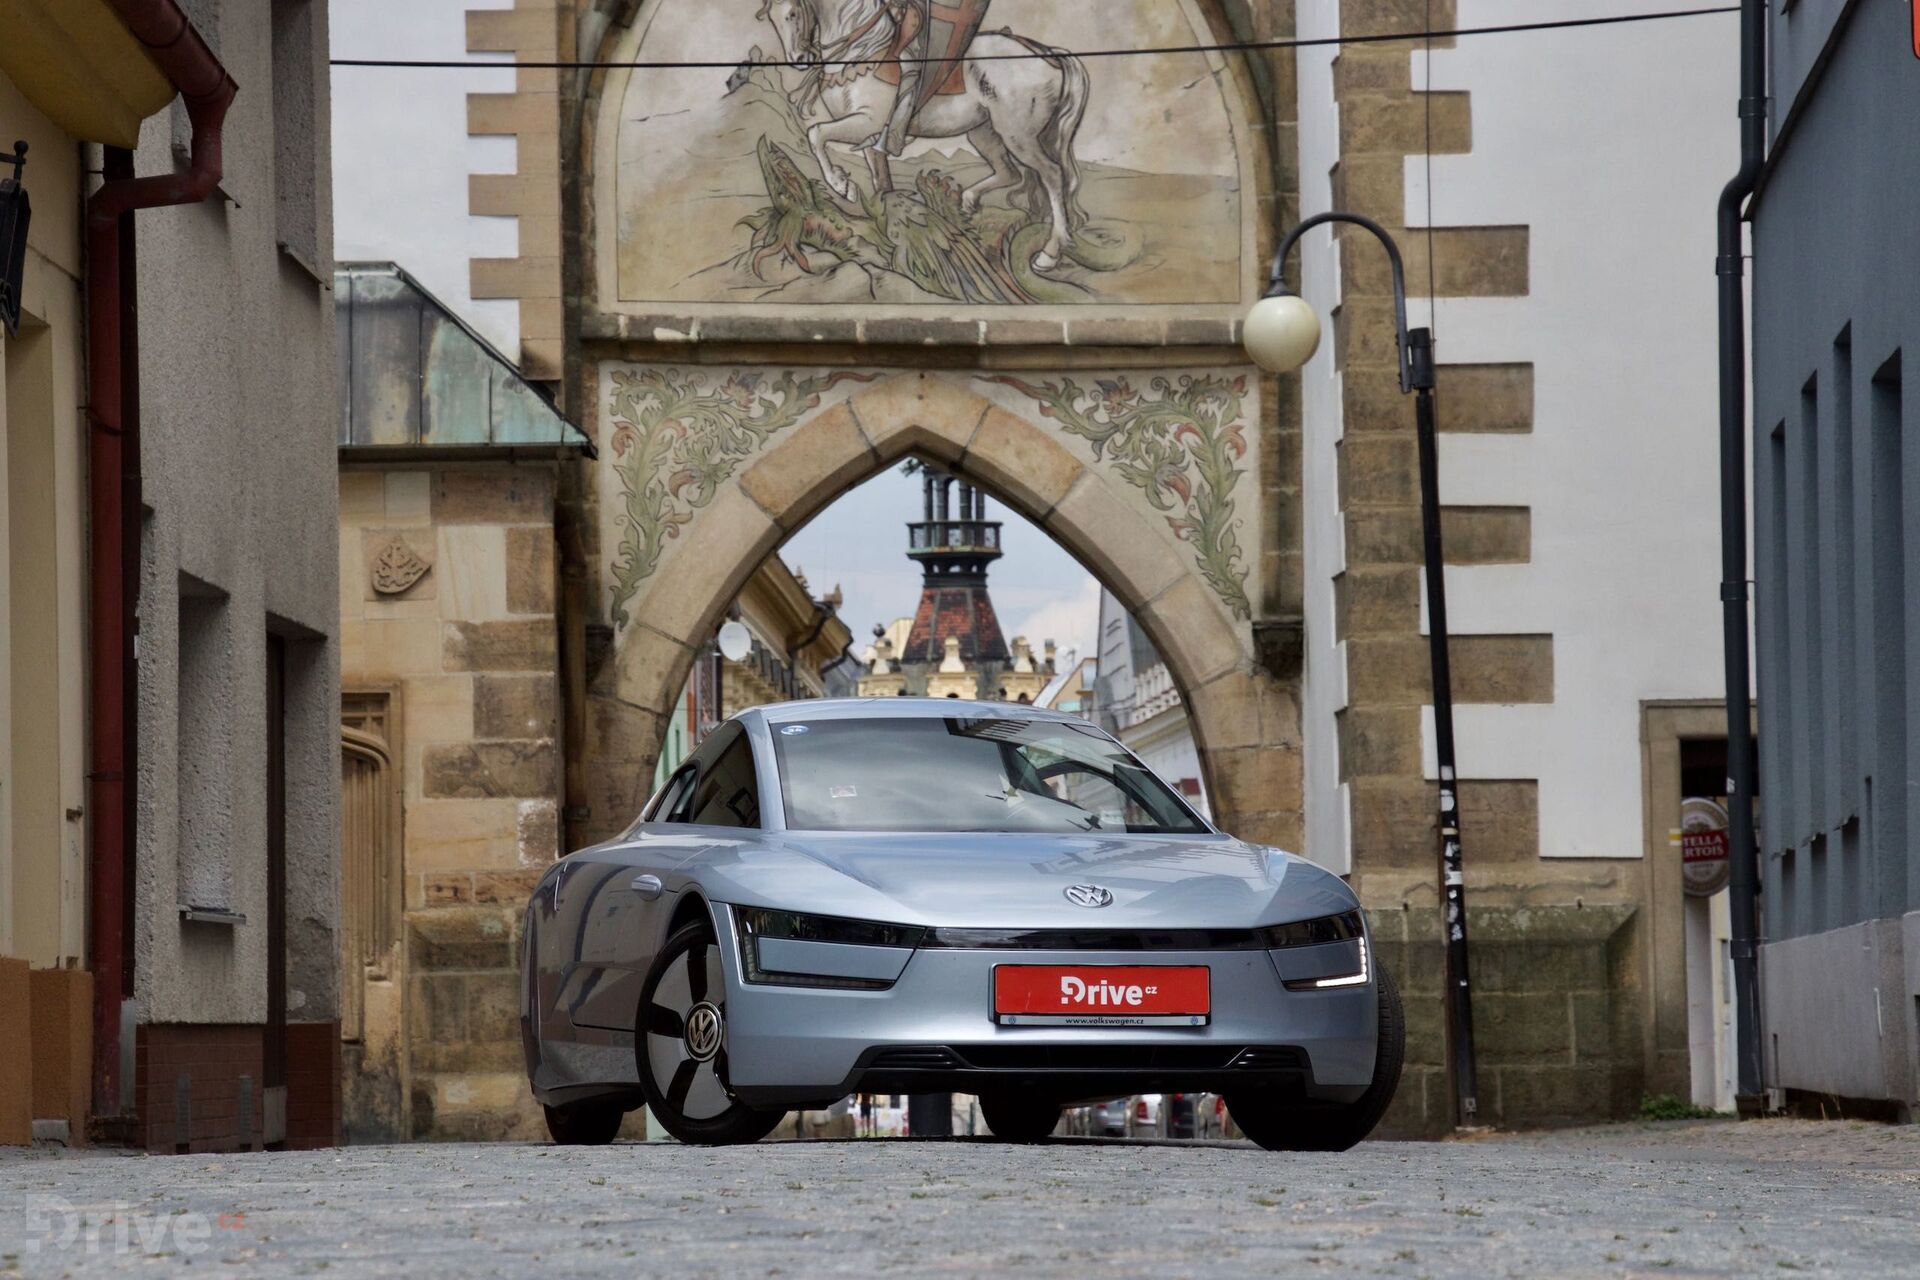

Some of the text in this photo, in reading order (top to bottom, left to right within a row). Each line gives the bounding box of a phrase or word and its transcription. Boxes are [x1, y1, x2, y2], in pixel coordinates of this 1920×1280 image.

[1684, 835, 1722, 847] TELLA
[1684, 847, 1724, 857] RTOIS
[1061, 976, 1143, 1006] Drive
[1065, 1017, 1144, 1026] www.volkswagen.cz
